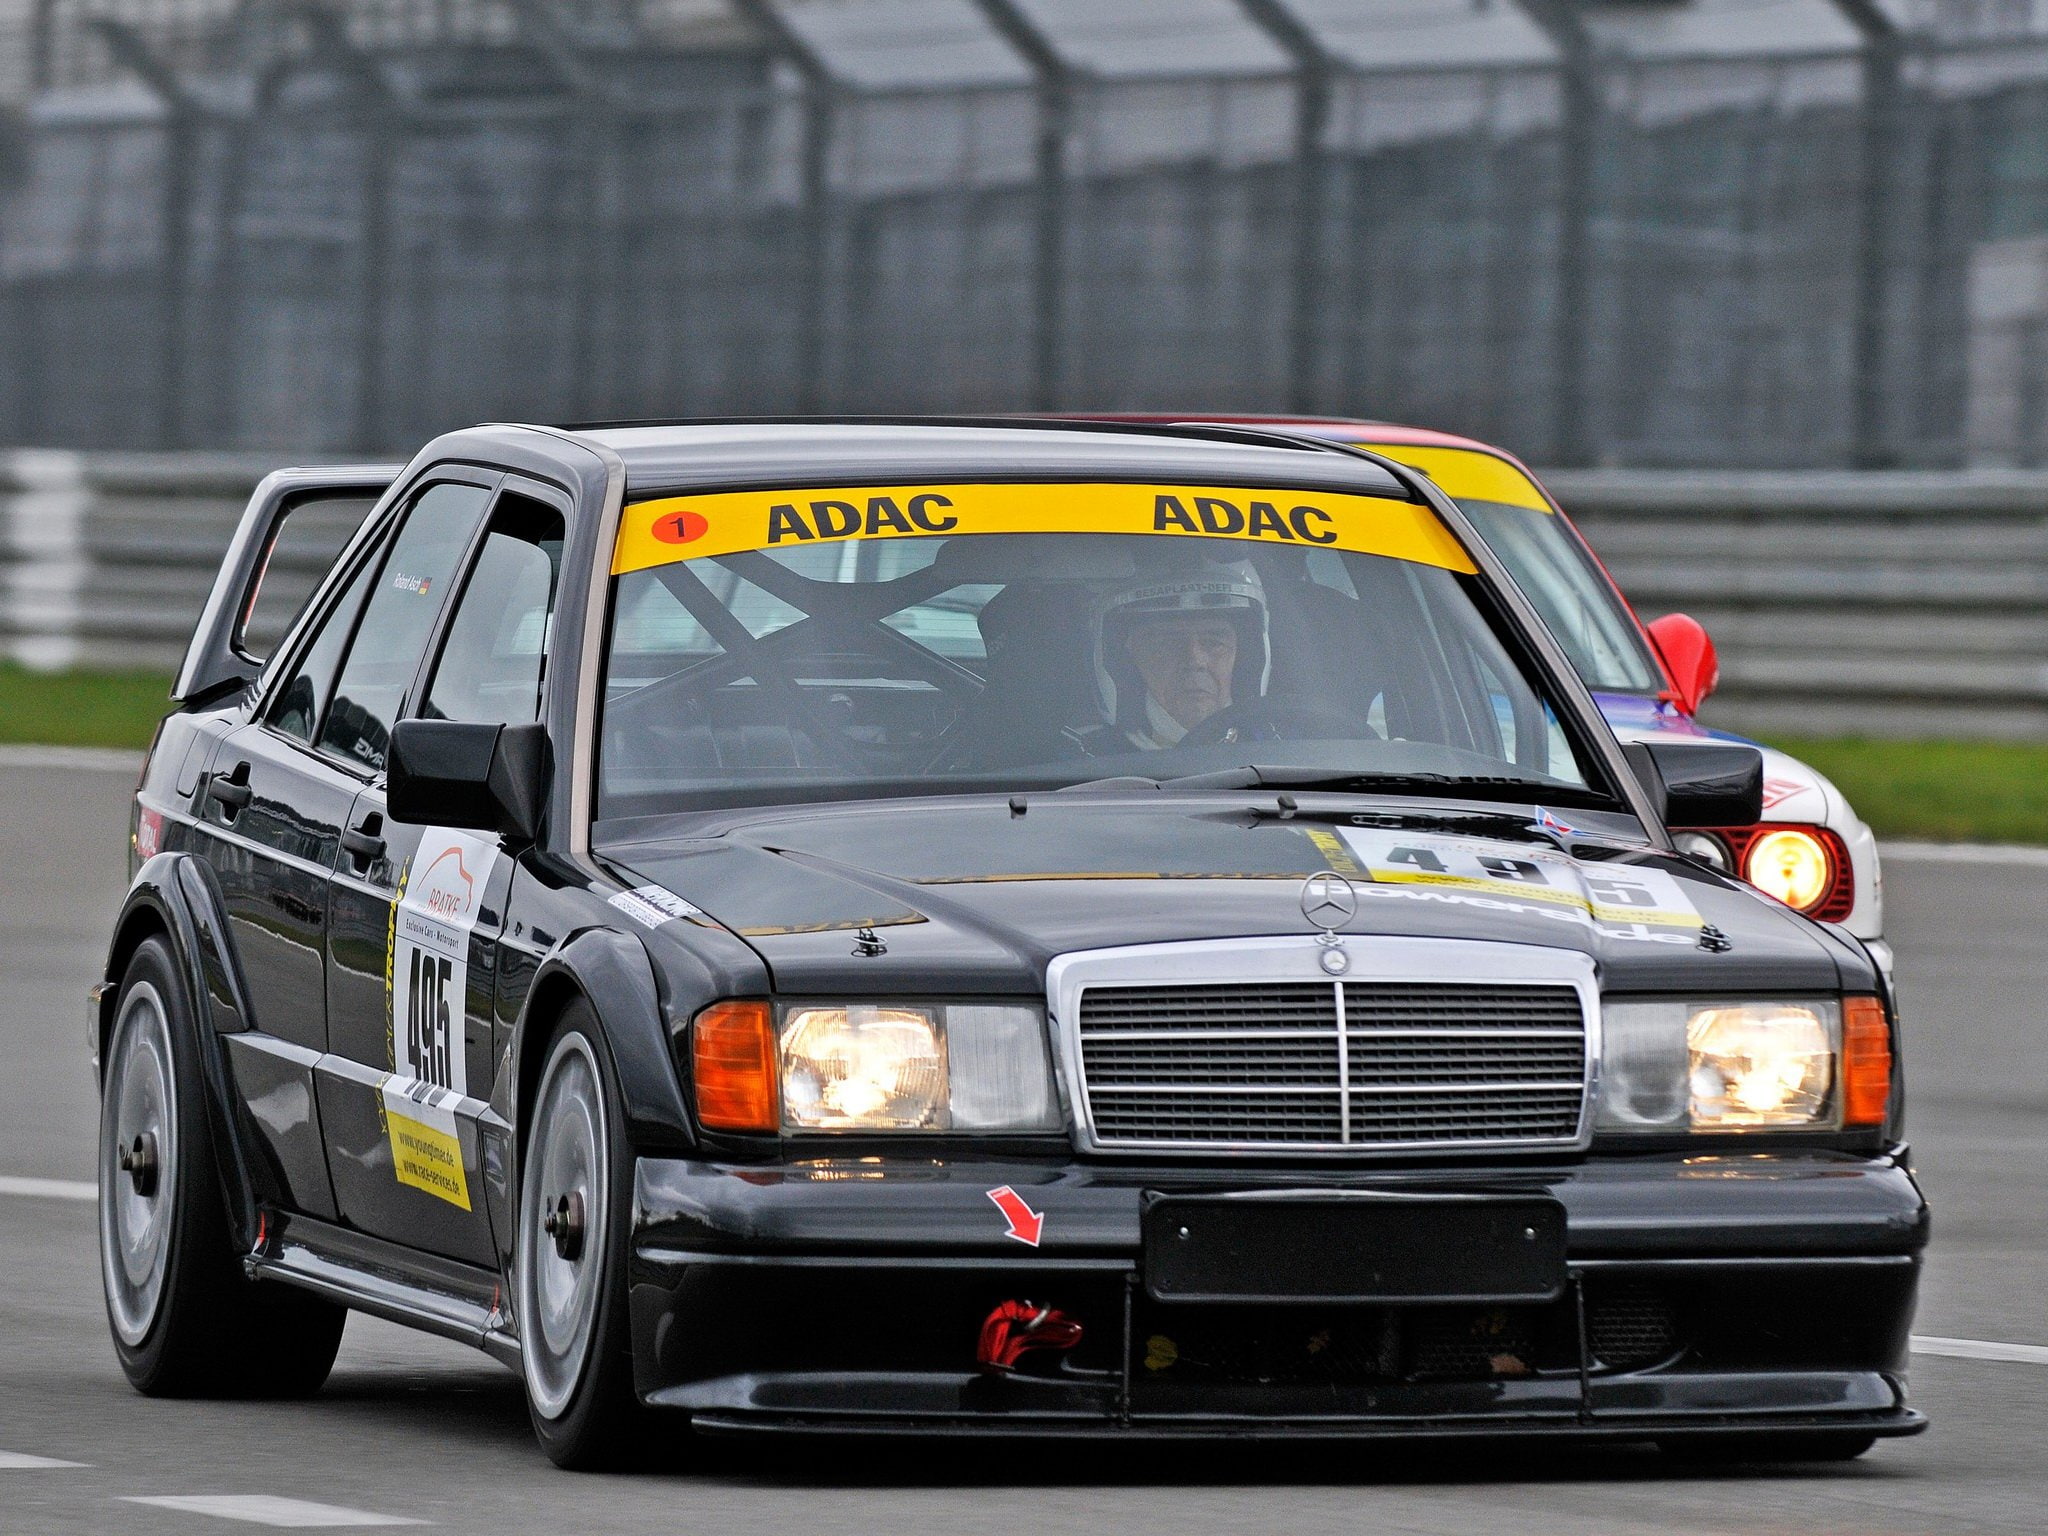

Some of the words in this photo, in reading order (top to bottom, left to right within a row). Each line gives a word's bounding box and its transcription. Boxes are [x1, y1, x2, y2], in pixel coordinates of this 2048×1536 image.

[668, 517, 686, 538] 1
[767, 494, 959, 544] ADAC
[1153, 494, 1338, 544] ADAC
[404, 946, 453, 1107] 495
[397, 1131, 455, 1168] www.youngtimer.de
[402, 1159, 461, 1197] www.race-services.de
